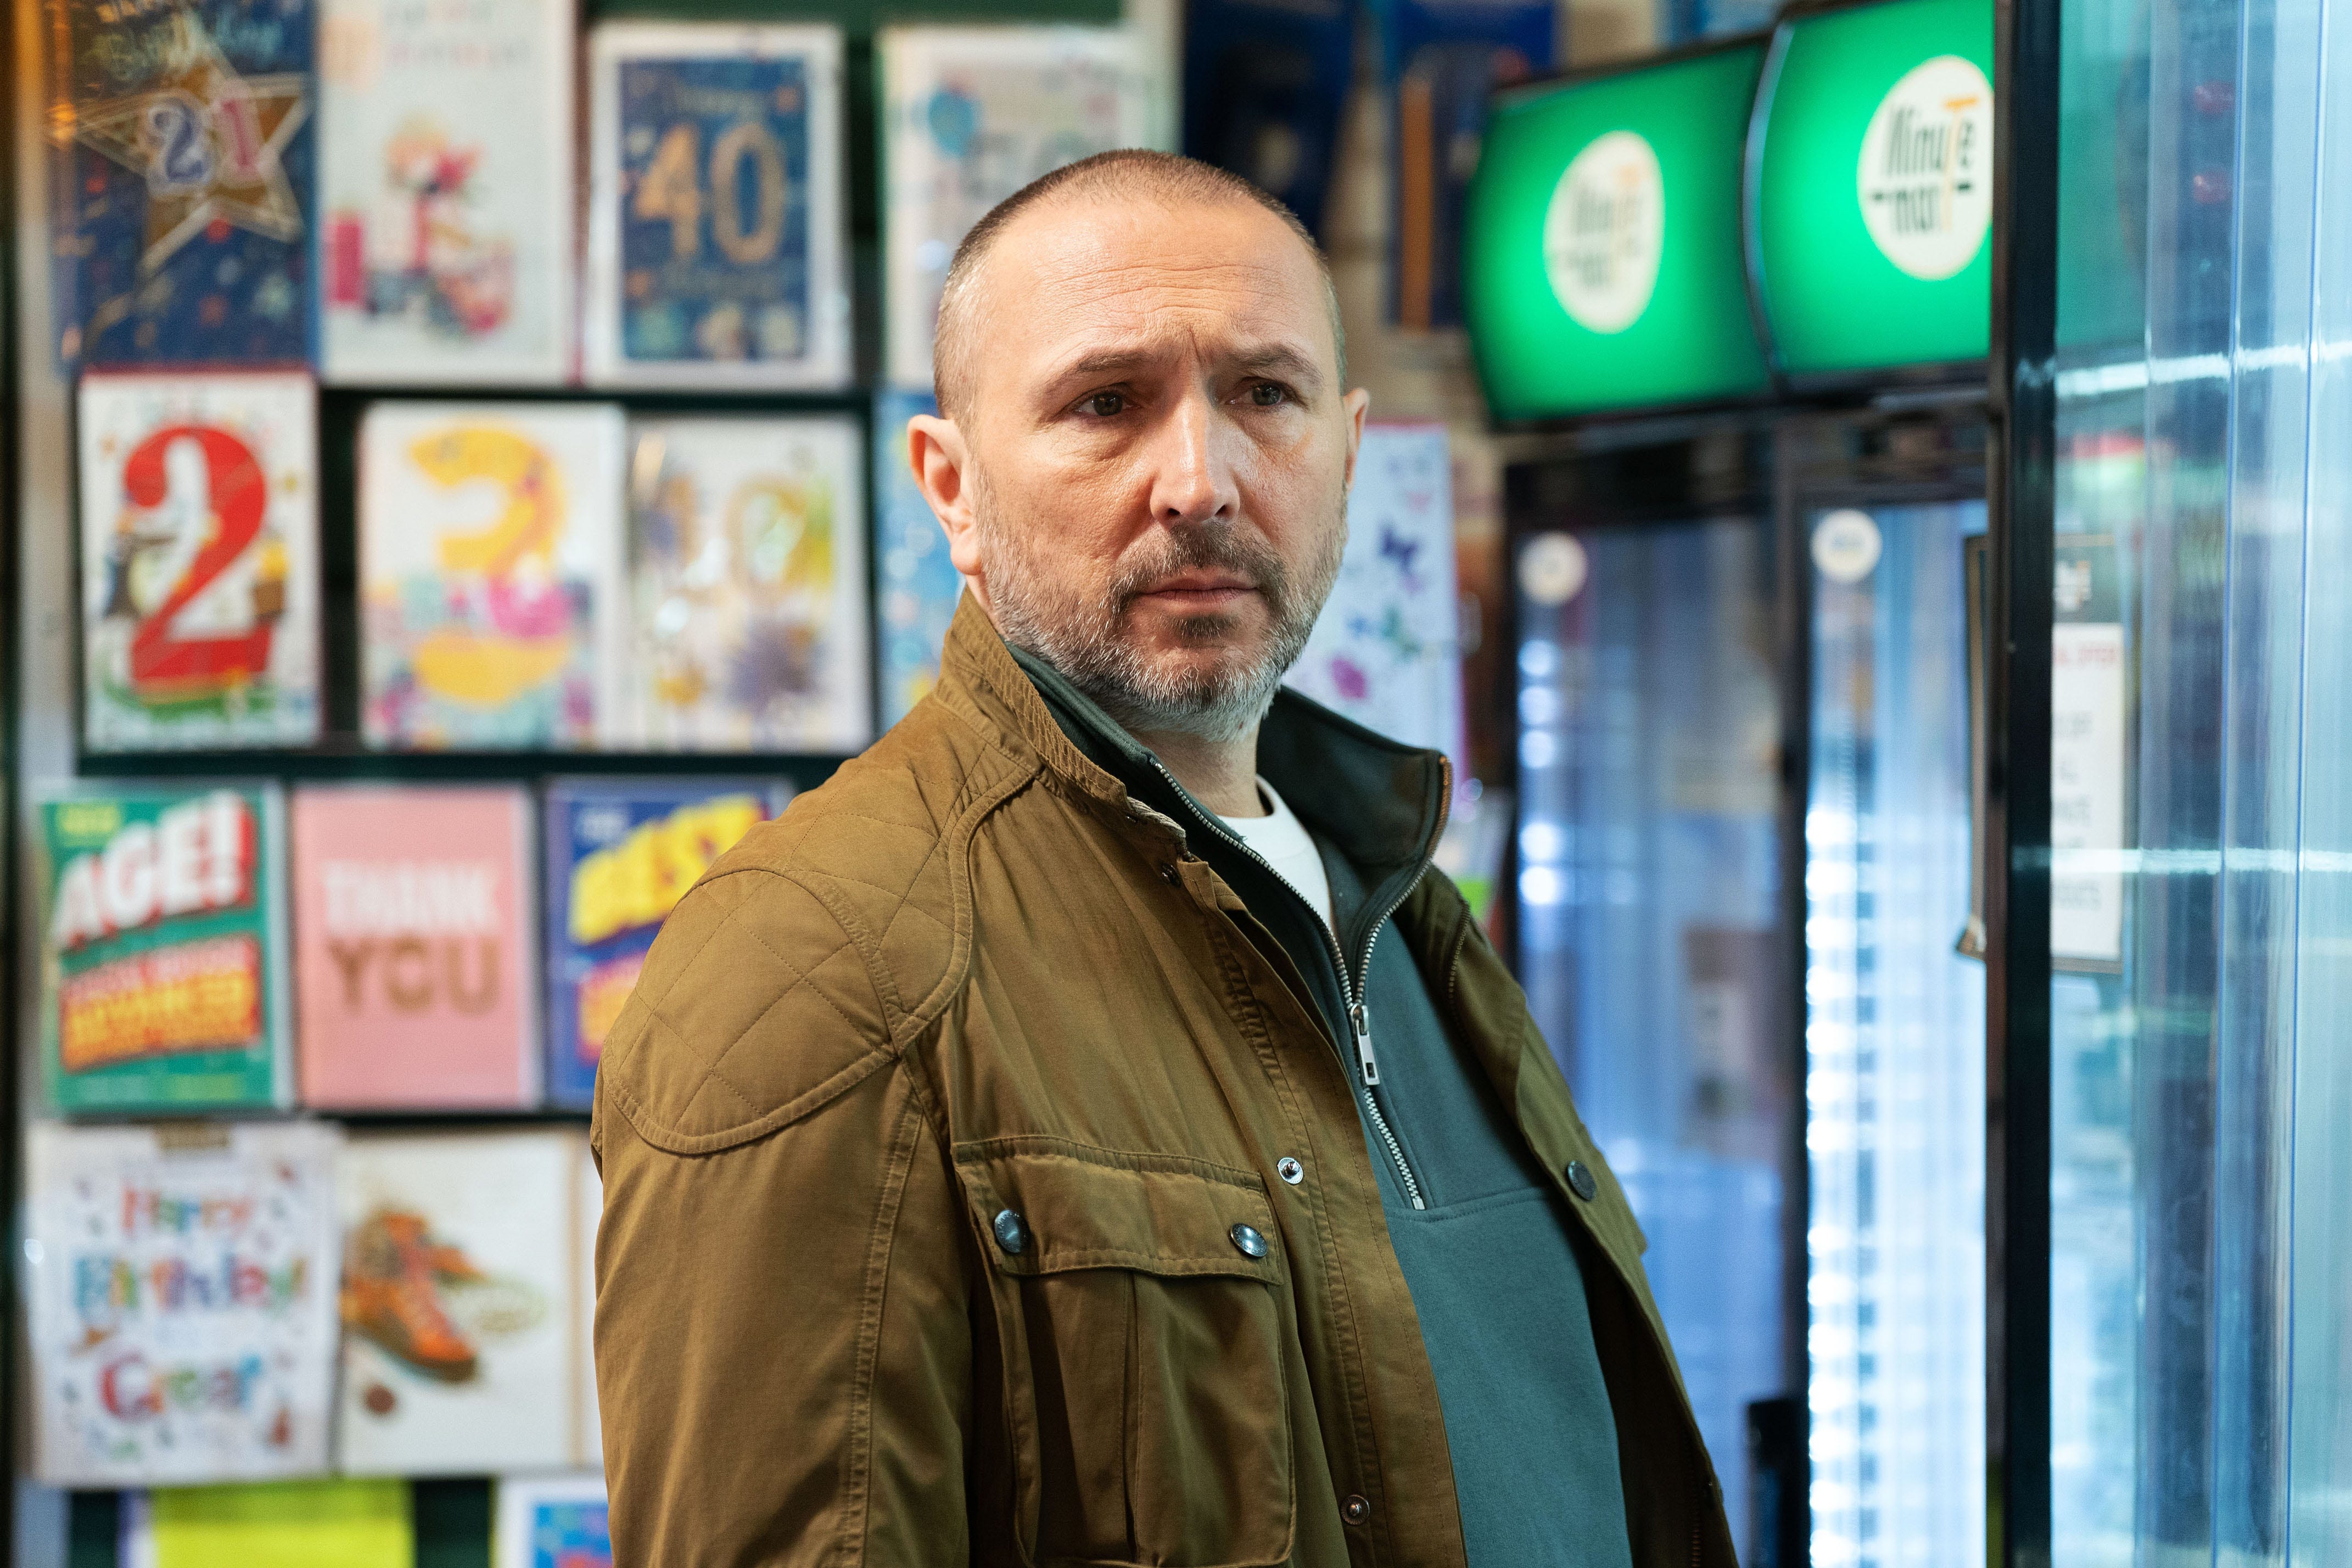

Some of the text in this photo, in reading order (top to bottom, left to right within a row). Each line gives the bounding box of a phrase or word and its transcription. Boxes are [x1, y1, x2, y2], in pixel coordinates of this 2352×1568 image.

[632, 122, 787, 265] 40
[125, 424, 270, 686] 2
[52, 789, 254, 951] AGE!
[320, 859, 497, 932] THANK
[326, 931, 501, 1018] YOU
